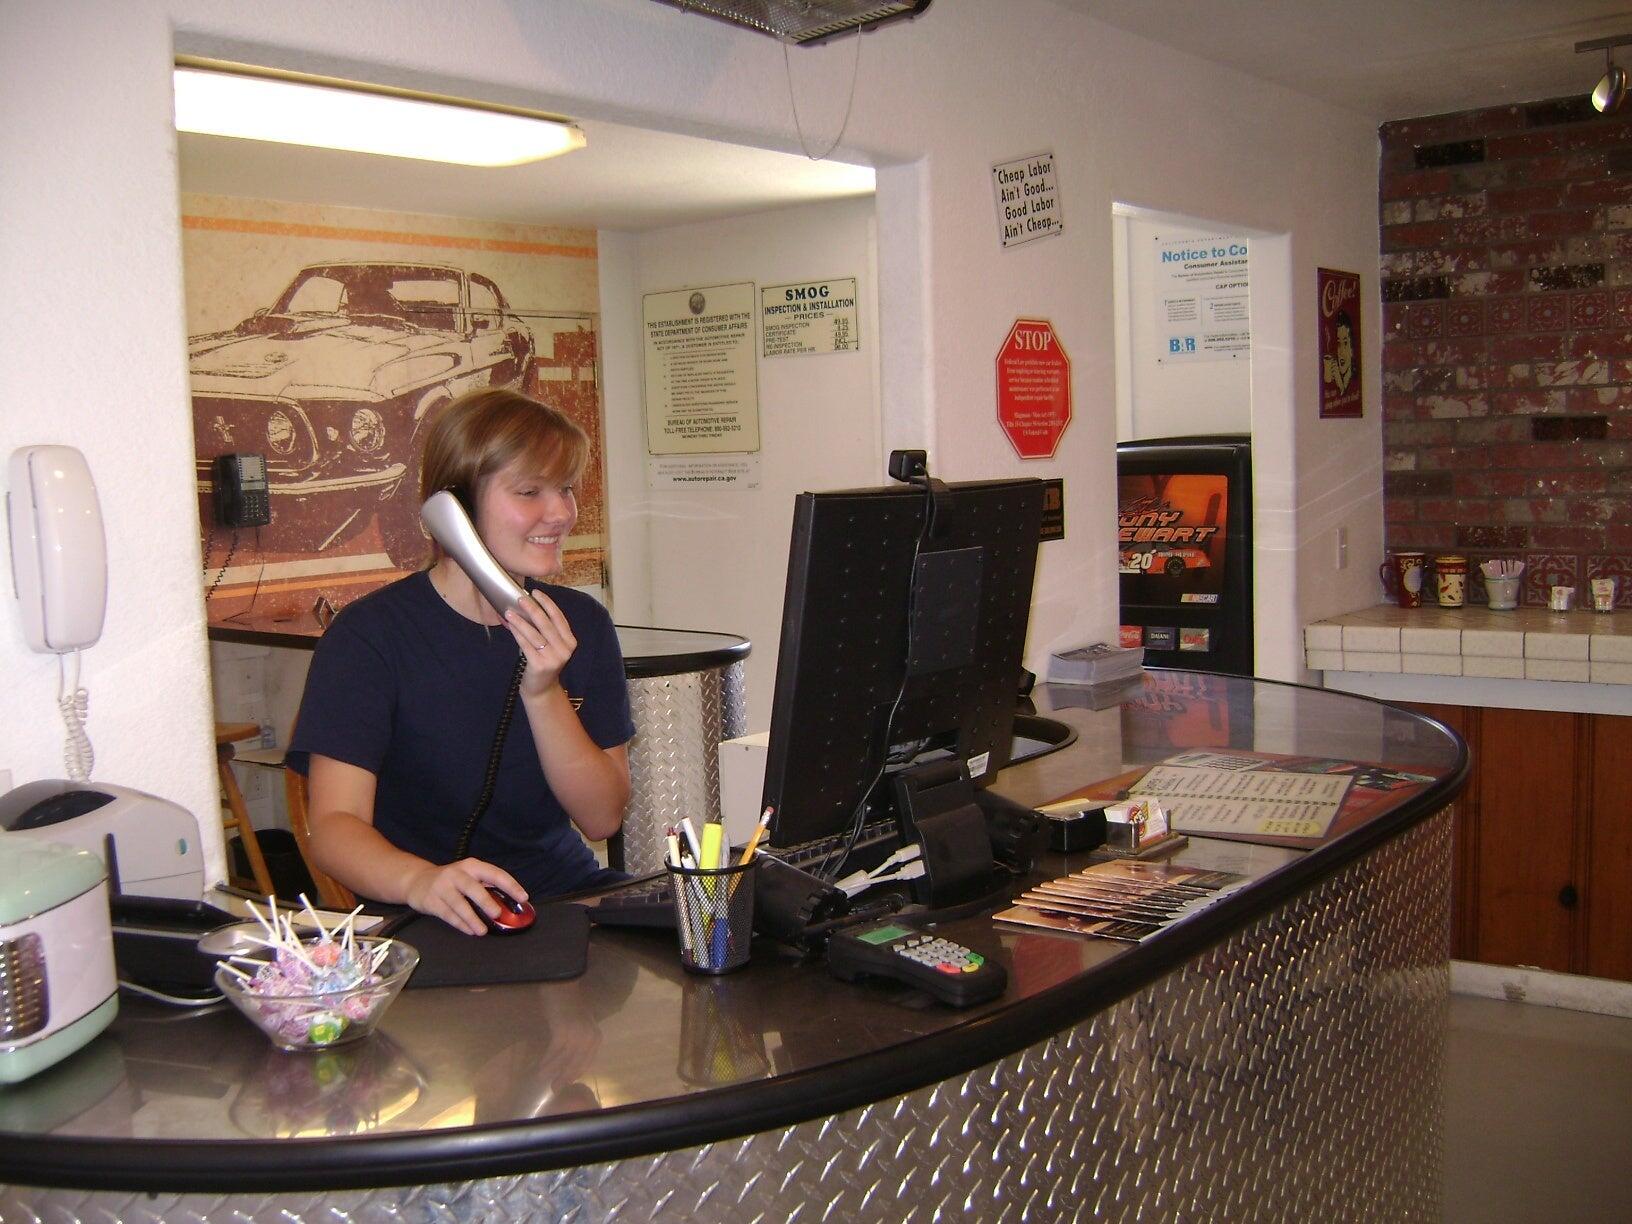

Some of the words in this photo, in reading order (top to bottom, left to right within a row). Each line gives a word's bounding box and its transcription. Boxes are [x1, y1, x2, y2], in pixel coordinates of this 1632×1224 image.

[998, 170, 1024, 184] Cheap
[1028, 160, 1050, 177] Labor
[1002, 187, 1019, 202] Ain't
[1024, 178, 1053, 196] Good...
[1006, 201, 1026, 220] Good
[1032, 197, 1054, 212] Labor
[1005, 223, 1022, 239] Ain't
[1027, 217, 1059, 231] Cheap...
[1162, 249, 1207, 262] Notice
[1212, 246, 1225, 257] to
[786, 286, 829, 301] SMOG
[1322, 279, 1356, 318] Coffee!
[765, 304, 801, 315] INSPECTION
[803, 303, 807, 311] &
[810, 299, 854, 310] INSTALLATION
[658, 318, 693, 328] ESTABLISHMENT
[700, 314, 728, 324] REGISTERED
[794, 312, 824, 320] PRICES
[651, 330, 664, 338] STATE
[665, 328, 693, 336] DEPARTMENT
[702, 325, 727, 333] CONSUMER
[1015, 330, 1051, 350] STOP
[673, 475, 736, 483] www.autorepair.ca.gov
[1129, 553, 1153, 569] 20
